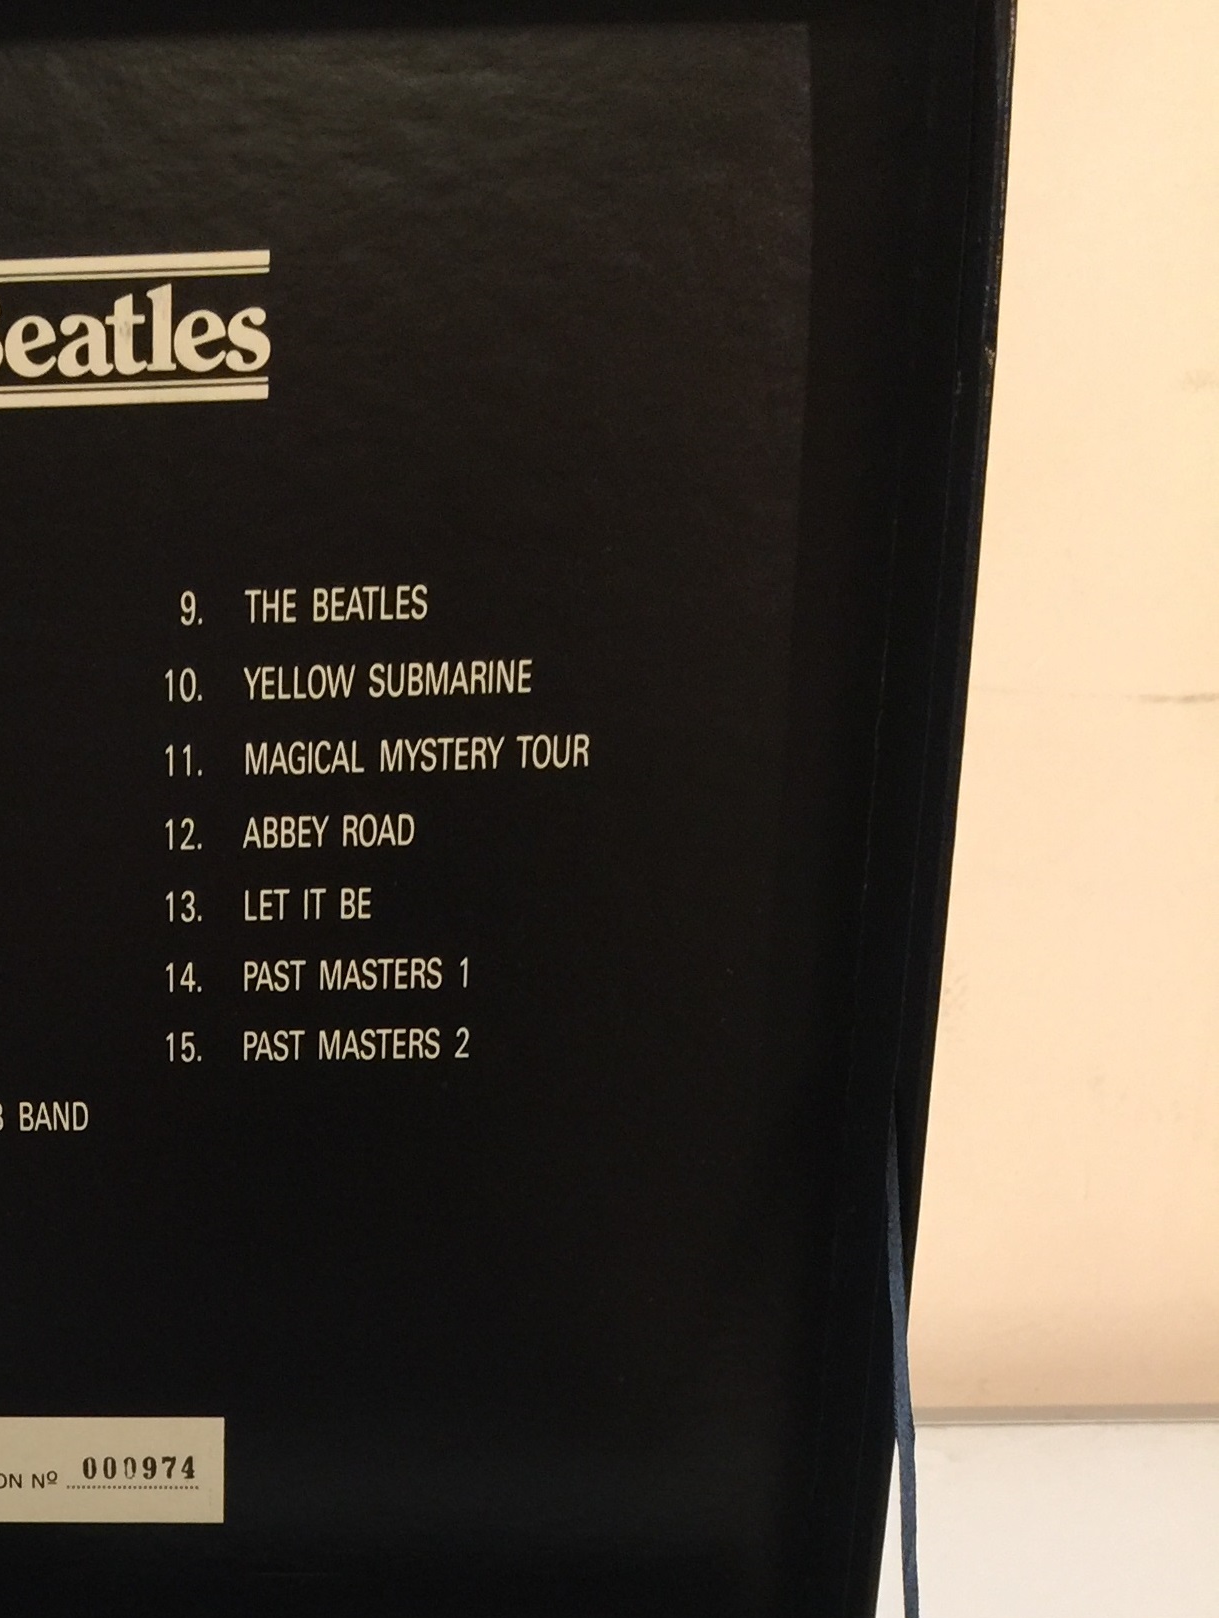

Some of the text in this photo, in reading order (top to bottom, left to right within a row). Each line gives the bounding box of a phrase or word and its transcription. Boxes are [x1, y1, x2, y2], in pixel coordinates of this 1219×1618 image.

[180, 583, 428, 626] 9. THE BEATLES
[164, 659, 533, 703] 10. YELLOW SUBMARINE
[165, 733, 590, 777] 11. MAGICAL MYSTERY TOUR
[165, 813, 415, 851] 12. ABBEY ROAD
[165, 887, 372, 923] 13. LET IT BE
[165, 956, 469, 993] 14. PAST MASTERS 1
[165, 1026, 470, 1063] 15. PAST MASTERS 2
[19, 1101, 89, 1132] BAND
[82, 1455, 196, 1481] 000974
